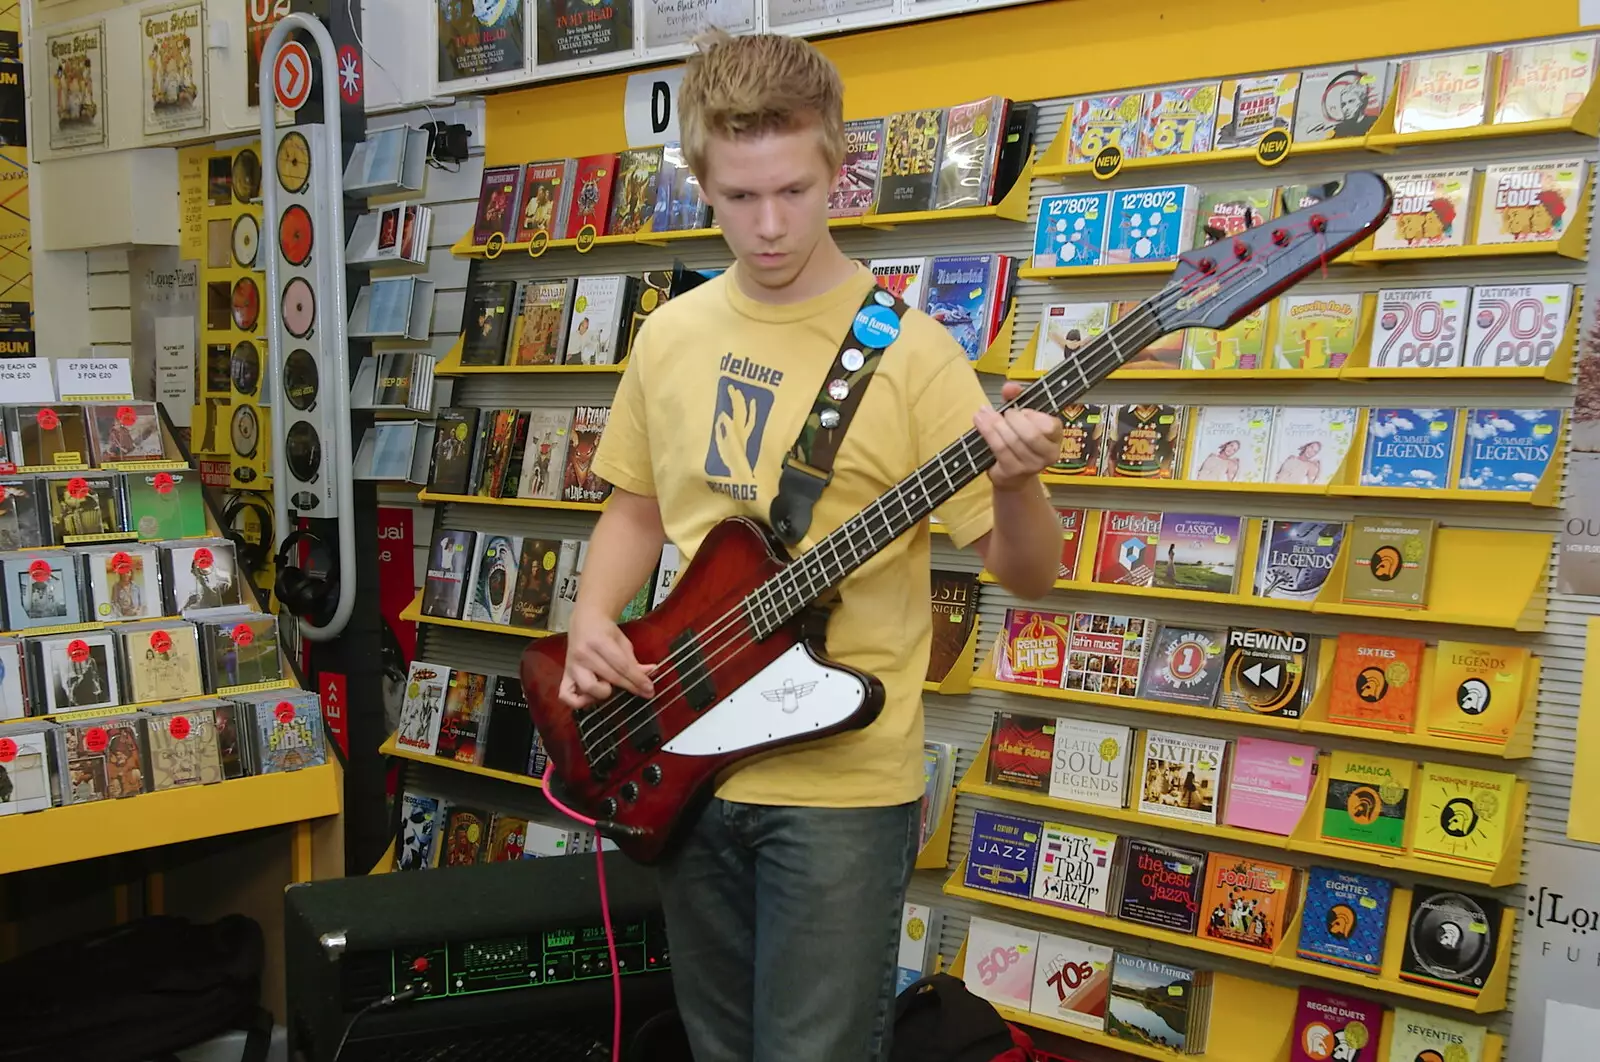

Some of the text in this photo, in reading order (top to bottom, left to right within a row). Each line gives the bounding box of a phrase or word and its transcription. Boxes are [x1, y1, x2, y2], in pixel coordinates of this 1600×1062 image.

[652, 81, 670, 133] D
[1081, 127, 1121, 157] 61
[1152, 120, 1197, 152] 61
[1260, 141, 1287, 154] NEW
[1096, 155, 1120, 168] NEW
[1394, 180, 1434, 199] SOUL
[1499, 171, 1544, 191] SOUL
[1391, 195, 1433, 215] LOVE
[1495, 188, 1544, 209] LOVE
[1214, 203, 1232, 215] the
[872, 264, 921, 276] GREEN DAY
[1384, 290, 1433, 303] ULTIMATE
[1480, 288, 1532, 300] ULTIMATE
[1376, 301, 1457, 367] 70s
[1472, 298, 1558, 367] 70s
[1397, 342, 1454, 368] POP
[1494, 341, 1555, 367] POP
[8, 362, 37, 371] EACH OR
[17, 371, 31, 379] £20
[89, 363, 108, 371] EACH
[109, 363, 118, 371] OR
[720, 352, 784, 387] deluxe
[587, 407, 612, 425] FLAME
[1392, 434, 1430, 444] SUMMER
[1493, 436, 1534, 447] SUMMER
[1375, 442, 1445, 460] LEGENDS
[1475, 444, 1550, 462] LEGENDS
[1175, 523, 1224, 536] CLASSICAL
[1272, 550, 1335, 570] LEGENDS
[1292, 545, 1315, 555] BLUES
[1072, 635, 1119, 652] latin music
[1229, 631, 1307, 654] REWIND
[1357, 646, 1397, 659] SIXTIES
[1015, 649, 1058, 670] HITS
[1451, 654, 1506, 670] LEGENDS
[1148, 743, 1219, 767] SIXTIES
[1199, 743, 1207, 751] OF
[1208, 744, 1220, 753] THE
[1055, 749, 1119, 779] SOUL
[1345, 763, 1392, 780] JAMAICA
[1054, 773, 1119, 795] LEGENDS
[1429, 774, 1501, 794] SUNSHINE REGGAE
[977, 841, 1027, 863] JAZZ
[1054, 856, 1095, 888] TRAD
[1137, 854, 1191, 890] the best
[1217, 868, 1276, 895] FORTIES
[1141, 872, 1184, 904] of jazz
[1325, 880, 1369, 896] EIGHTIES
[977, 946, 1020, 988] 50s
[1046, 961, 1093, 1002] 70s
[1306, 1000, 1366, 1022] REGGAE DUETS
[1407, 1023, 1464, 1046] SEVENTIES
